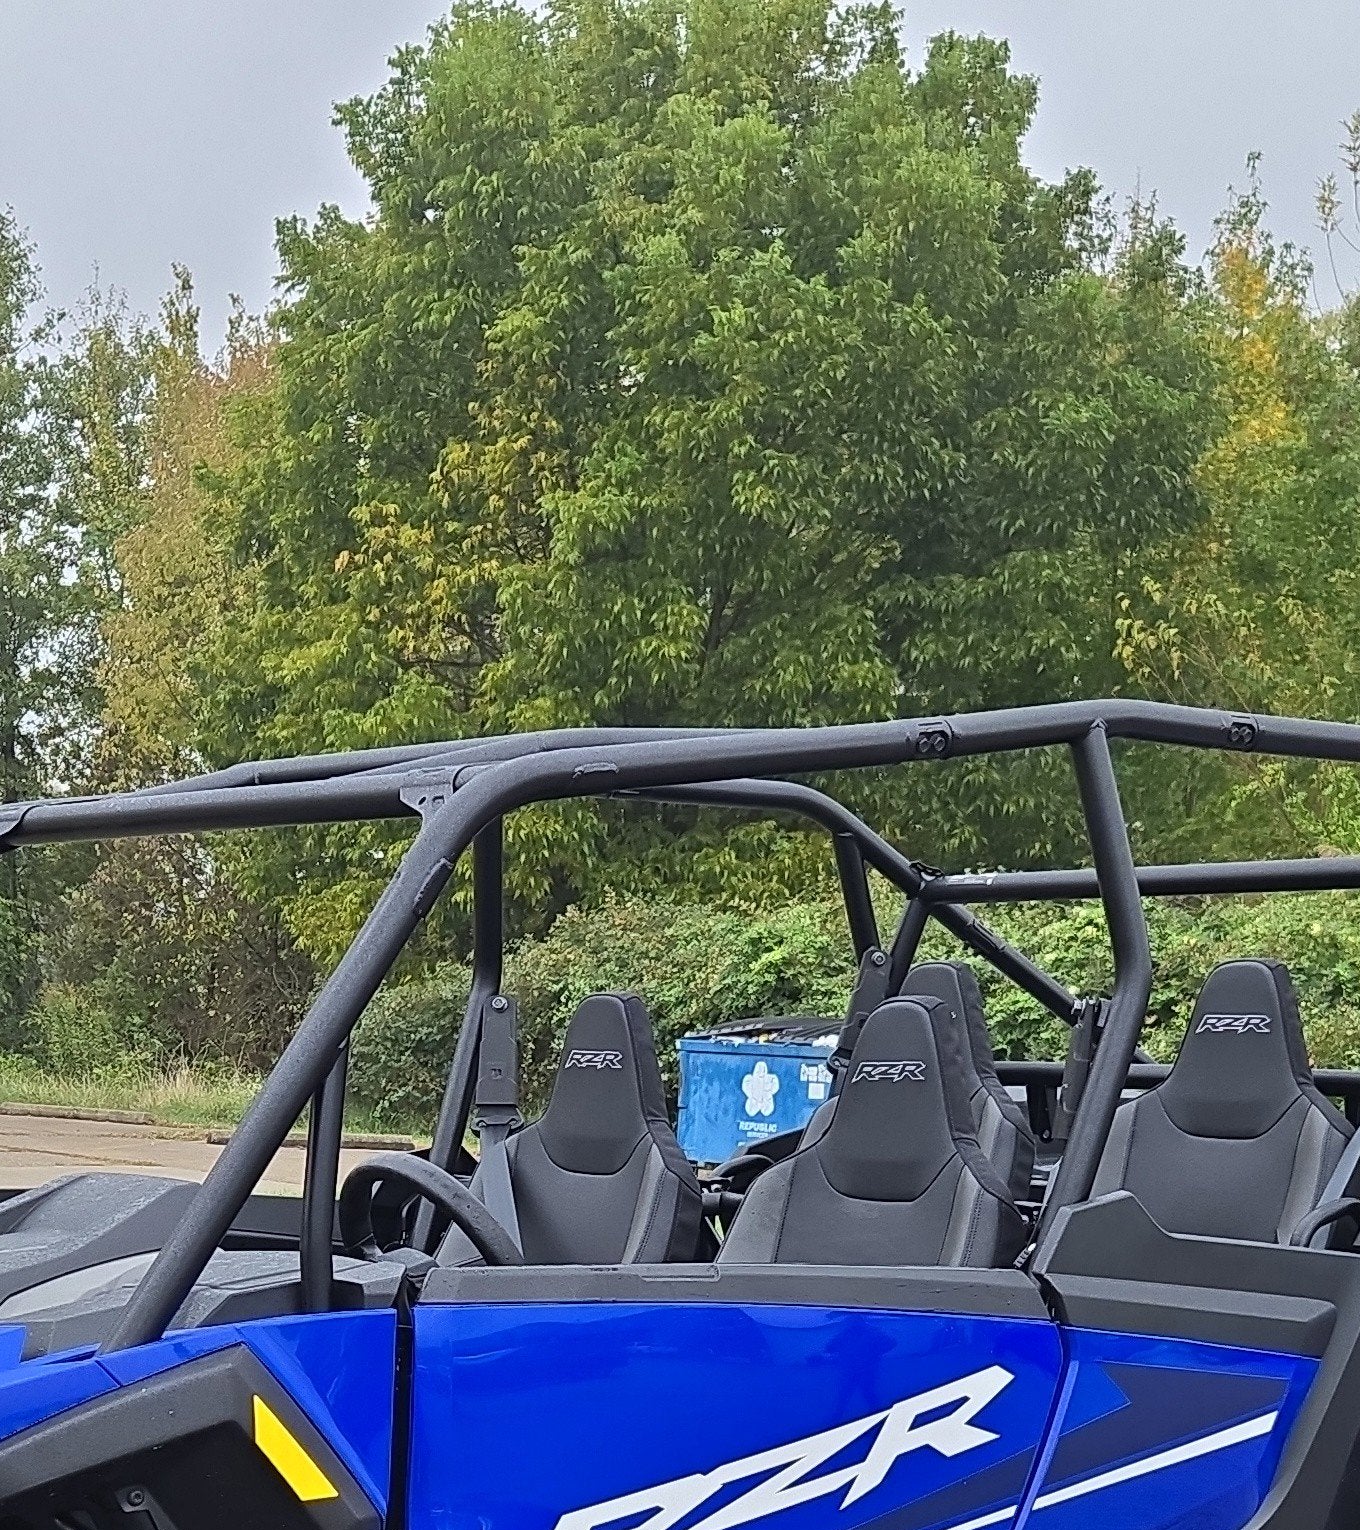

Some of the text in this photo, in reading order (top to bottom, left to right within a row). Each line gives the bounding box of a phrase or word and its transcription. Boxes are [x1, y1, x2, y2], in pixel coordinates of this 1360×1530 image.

[1195, 1014, 1272, 1034] RZR
[564, 1049, 623, 1069] RZR
[851, 1061, 926, 1083] RZR
